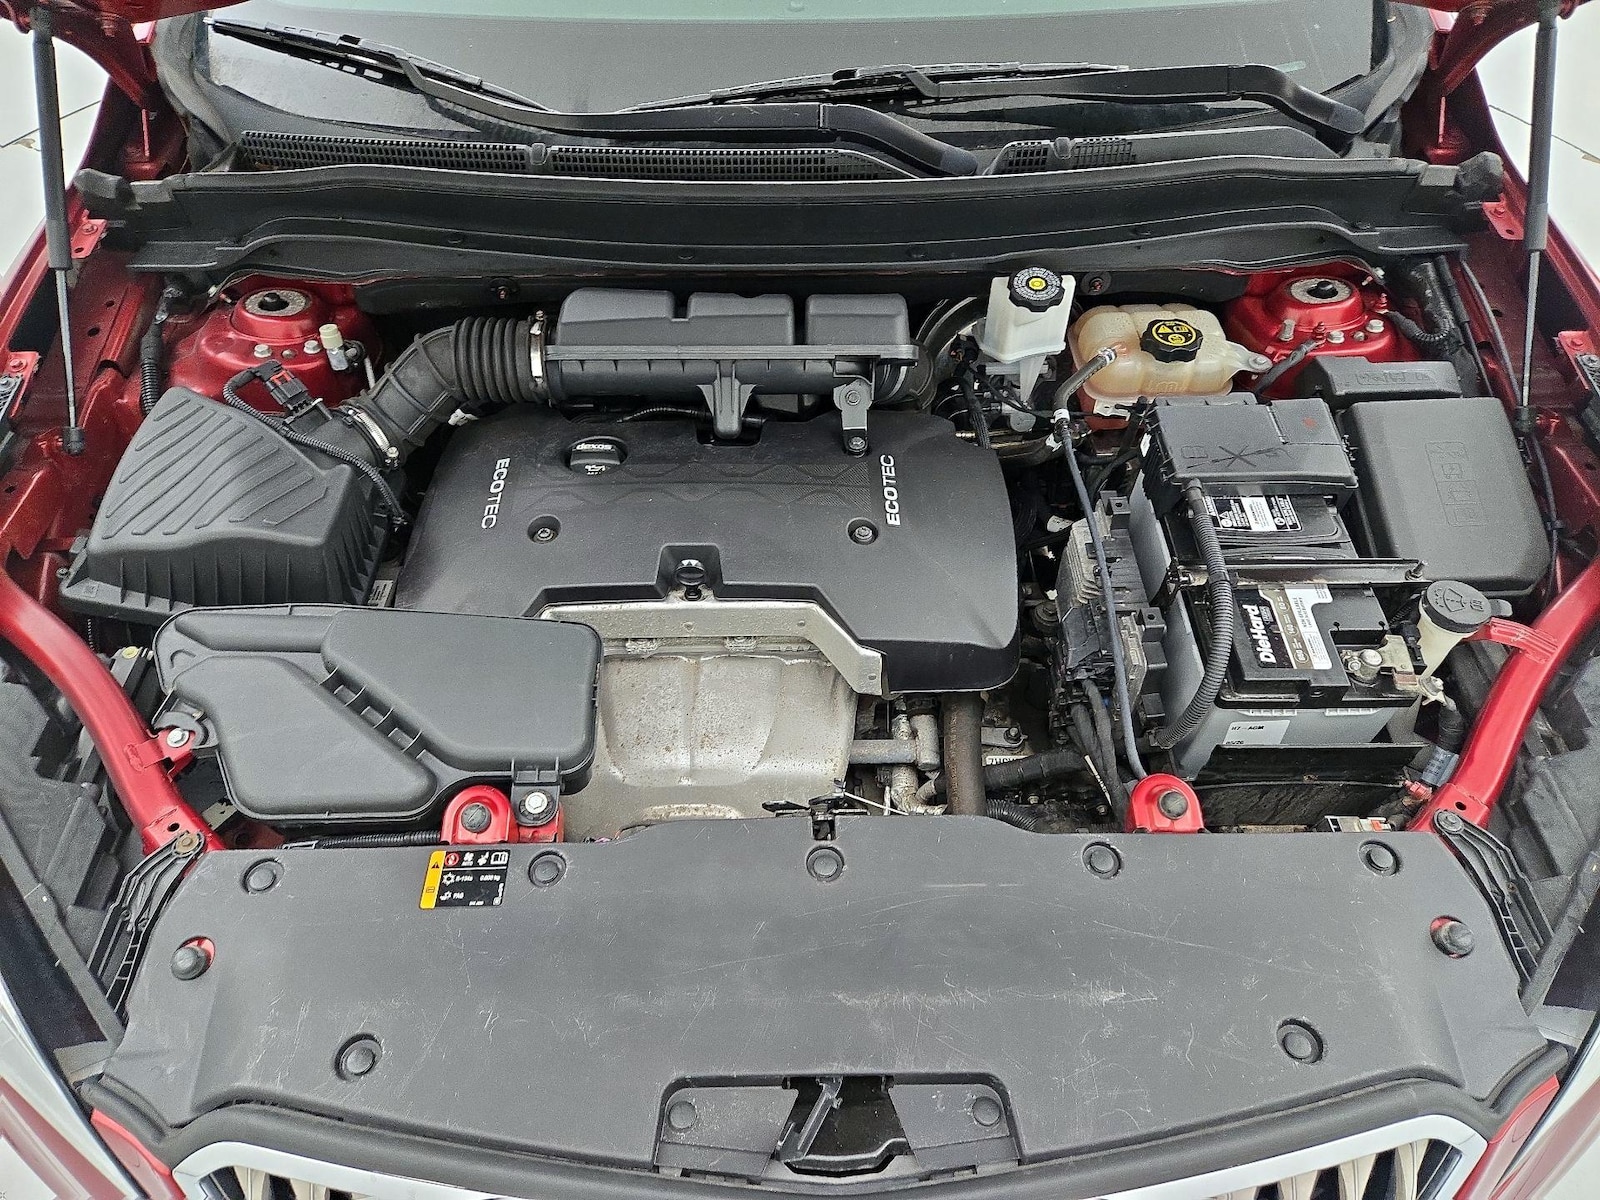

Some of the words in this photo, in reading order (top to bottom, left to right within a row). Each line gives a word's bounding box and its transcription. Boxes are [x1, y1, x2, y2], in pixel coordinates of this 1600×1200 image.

[481, 457, 511, 529] ECOTEC
[880, 455, 901, 526] ECOTEC
[1242, 604, 1277, 663] DieHard
